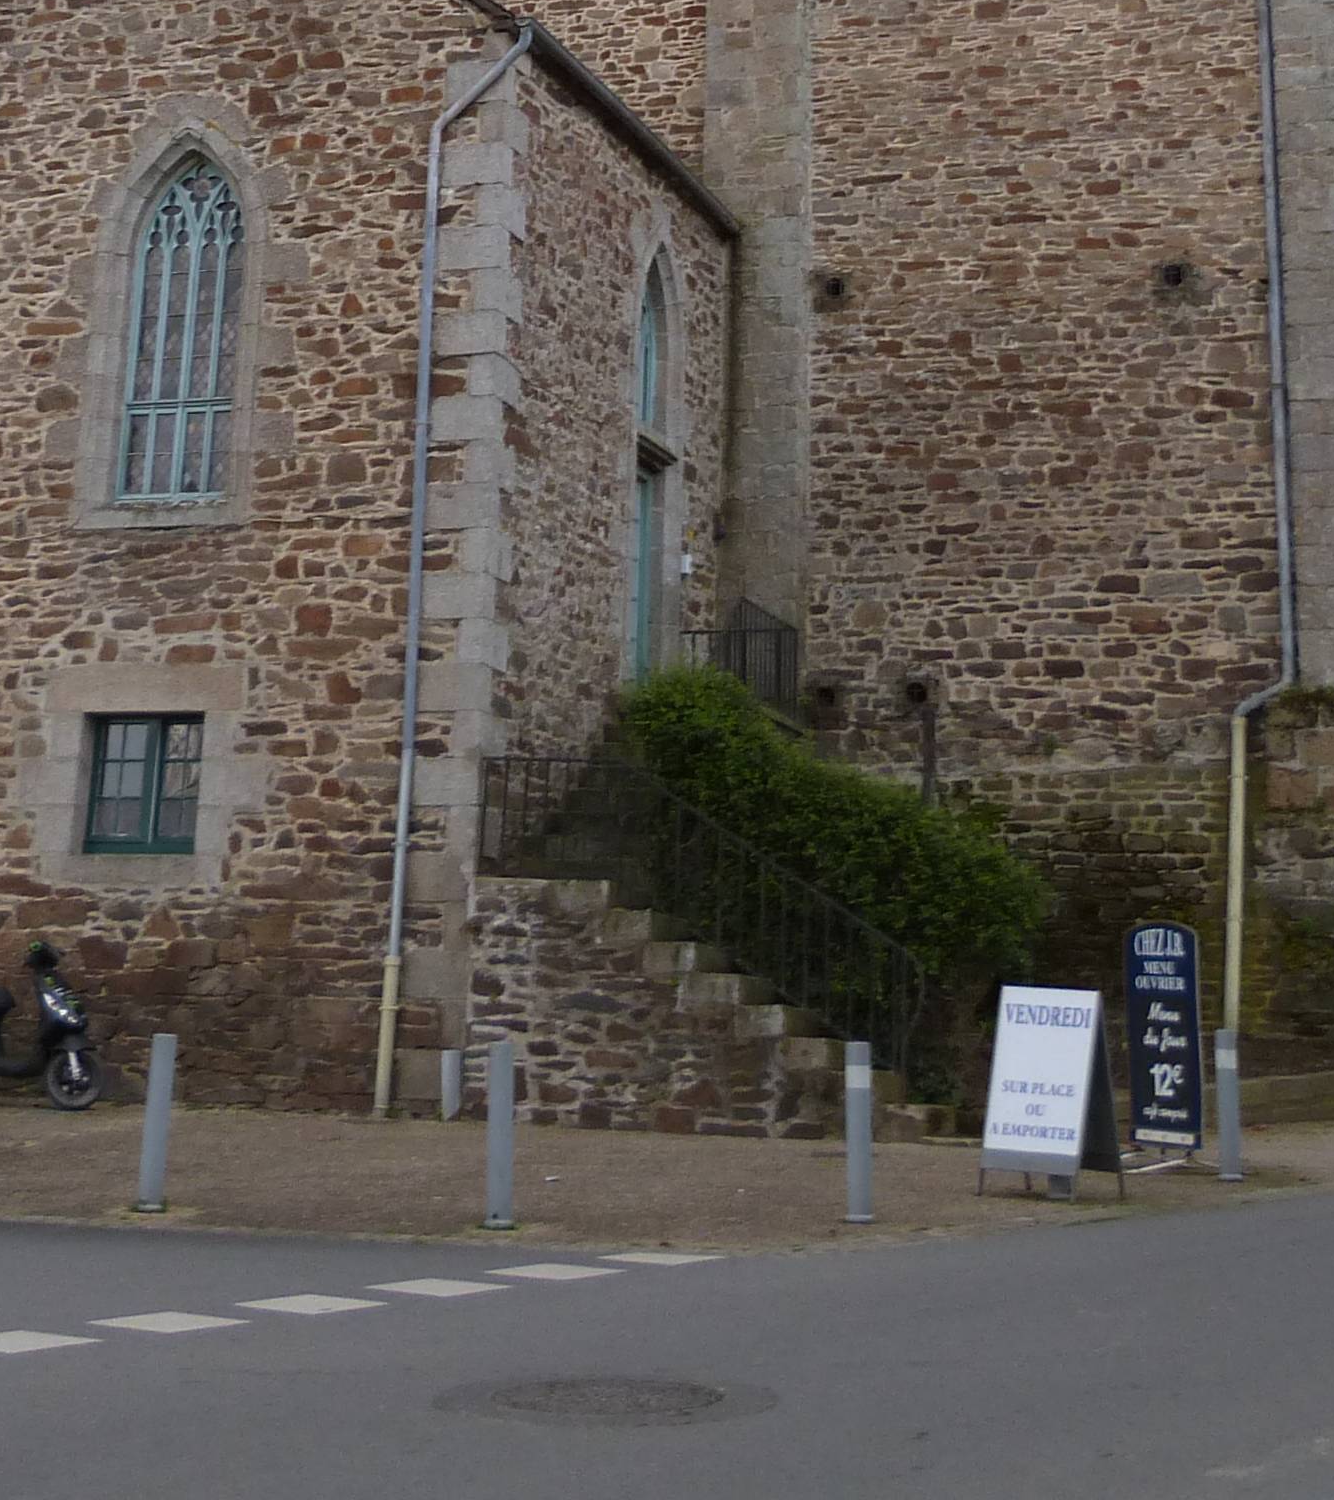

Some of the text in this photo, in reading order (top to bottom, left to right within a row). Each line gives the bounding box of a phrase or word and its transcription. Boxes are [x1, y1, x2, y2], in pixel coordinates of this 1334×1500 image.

[1134, 928, 1165, 956] CHEZ
[1143, 961, 1177, 975] MENU
[1135, 975, 1185, 990] OUVRIER
[1006, 1003, 1092, 1028] VENDREDI
[1002, 1080, 1075, 1097] SUR PLACE
[1025, 1103, 1047, 1117] OU
[1002, 1123, 1078, 1141] EMPORTER
